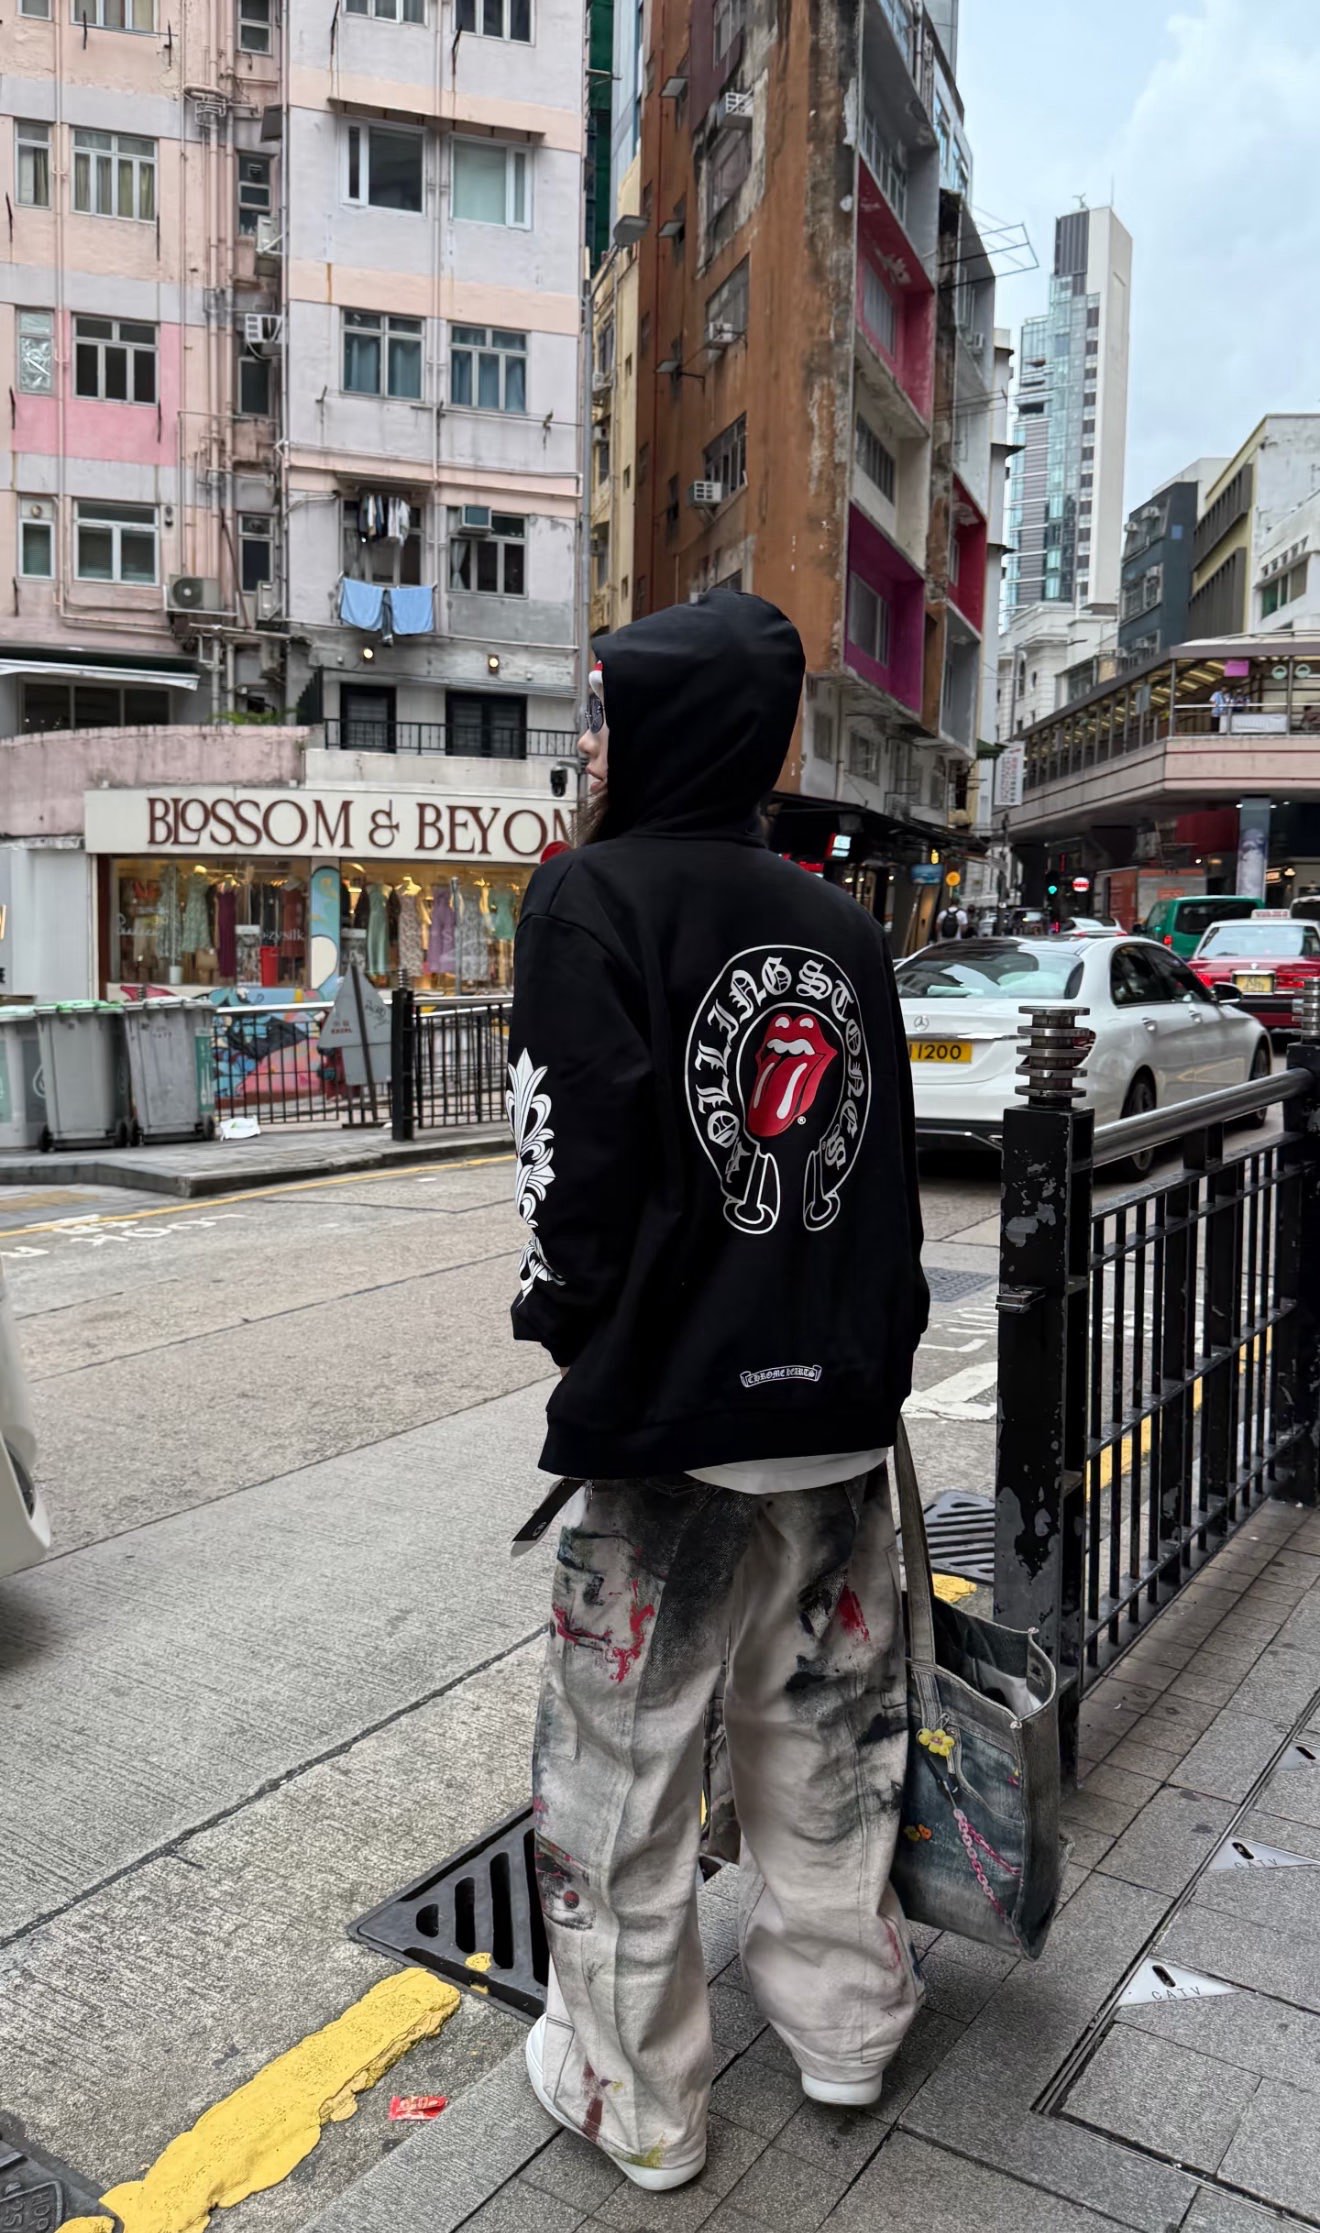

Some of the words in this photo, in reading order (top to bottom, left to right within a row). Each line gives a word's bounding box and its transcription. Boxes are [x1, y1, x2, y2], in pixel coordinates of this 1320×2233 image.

[147, 797, 353, 848] BLOSSOM
[368, 798, 400, 848] &
[796, 959, 865, 1170] STONES
[1151, 1986, 1202, 2001] CATV
